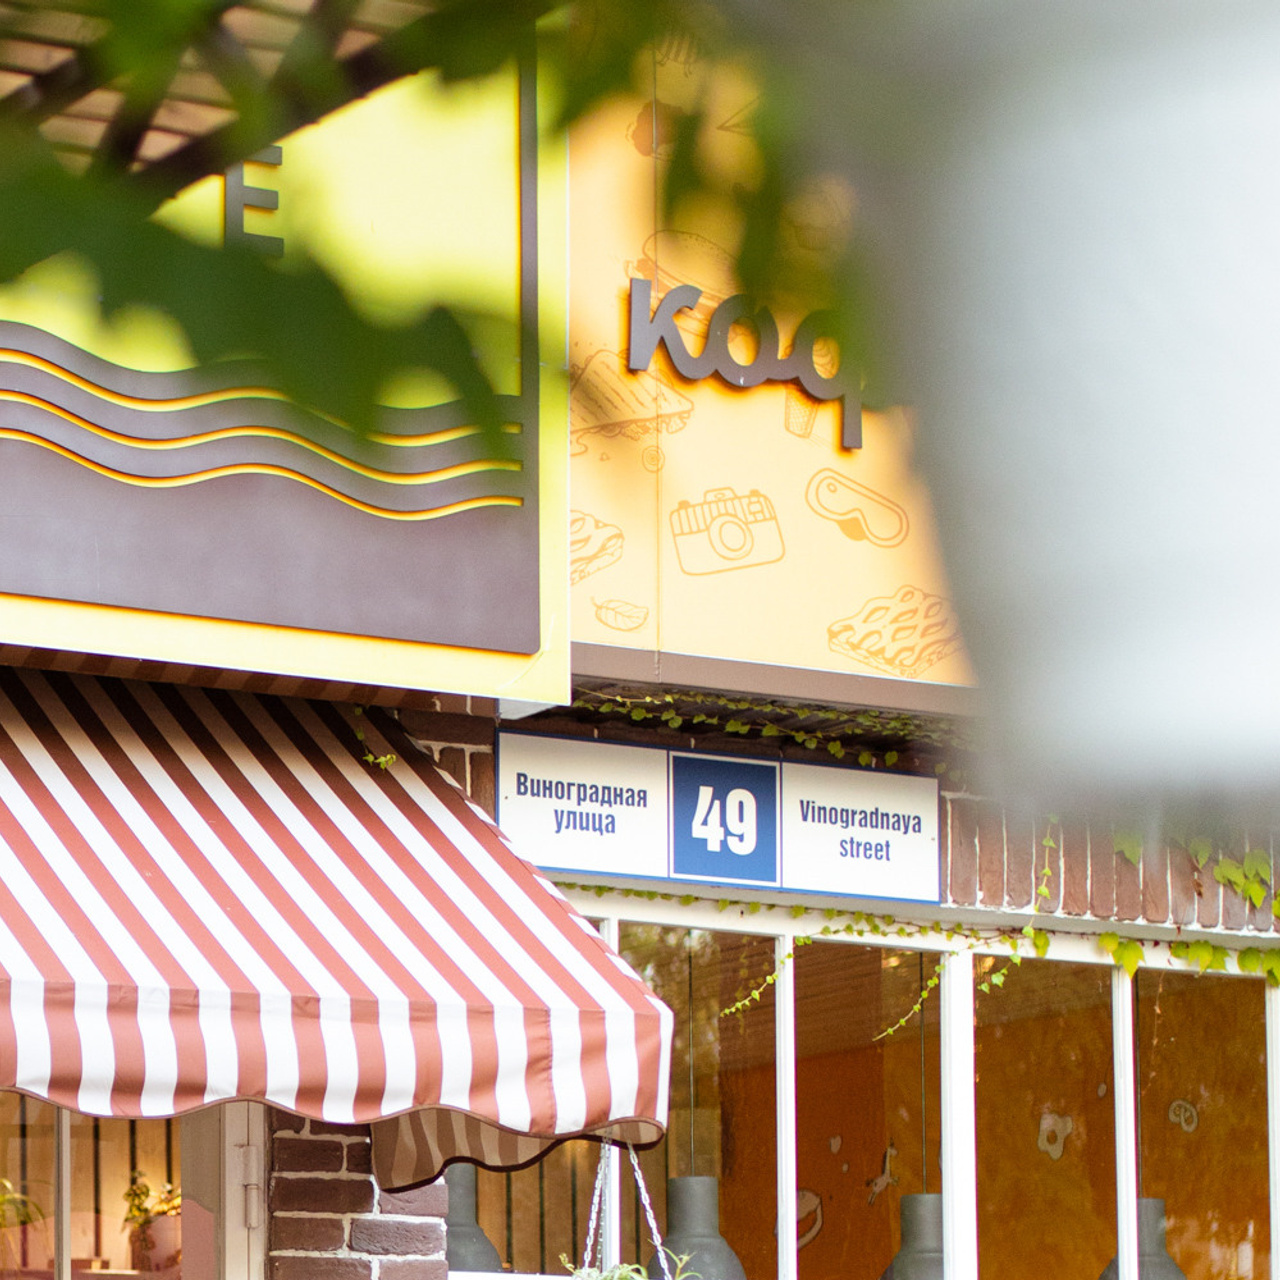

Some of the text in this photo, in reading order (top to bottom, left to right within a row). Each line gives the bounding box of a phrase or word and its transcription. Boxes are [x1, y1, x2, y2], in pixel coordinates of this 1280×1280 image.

[516, 772, 648, 808] Виноградная
[554, 806, 616, 836] улица
[691, 785, 757, 856] 49
[800, 799, 922, 834] Vinogradnaya
[839, 836, 891, 862] street
